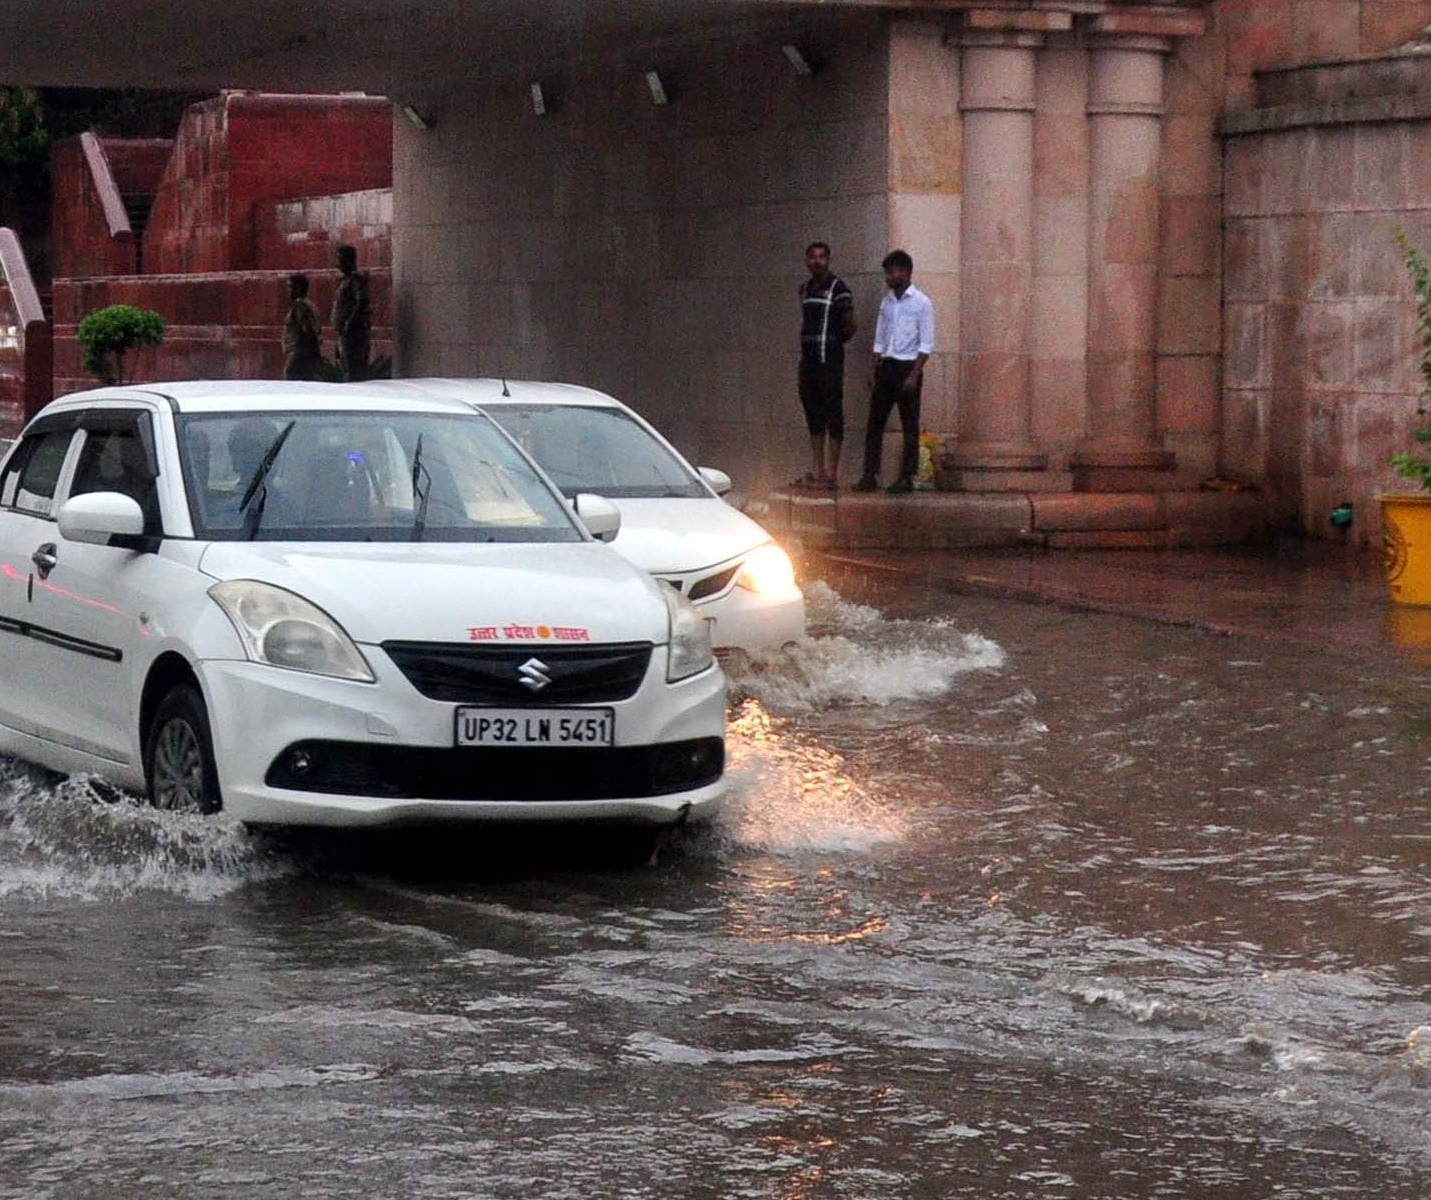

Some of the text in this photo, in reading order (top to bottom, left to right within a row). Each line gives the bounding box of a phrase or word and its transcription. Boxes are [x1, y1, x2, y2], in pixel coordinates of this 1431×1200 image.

[466, 627, 499, 640] उत्तर
[503, 624, 536, 640] प्रदेश
[465, 717, 606, 742] UP32 LN 5451
